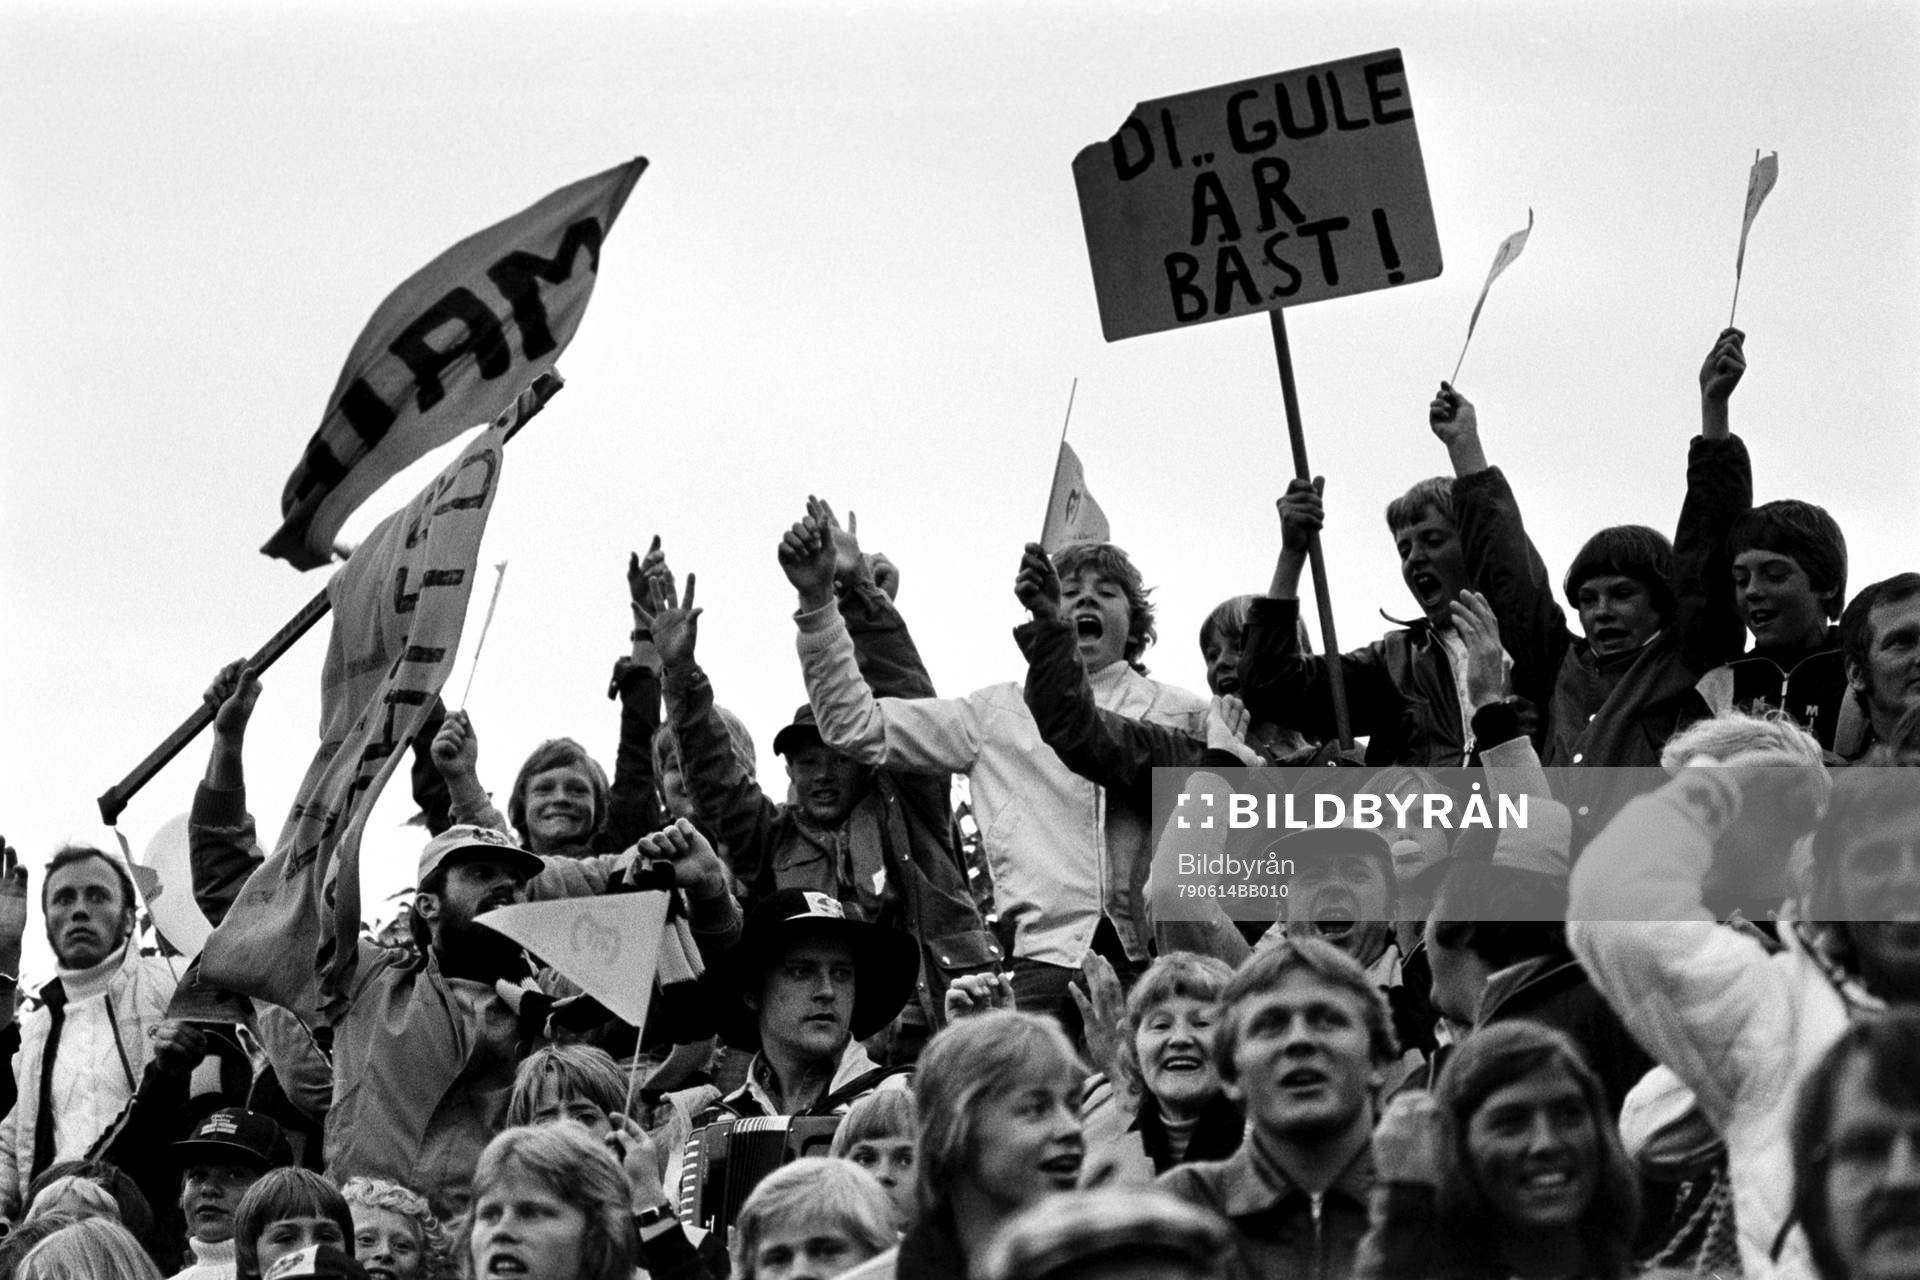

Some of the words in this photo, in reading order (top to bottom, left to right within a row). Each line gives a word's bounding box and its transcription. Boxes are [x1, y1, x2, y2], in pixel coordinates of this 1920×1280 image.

[1112, 108, 1183, 182] DI
[1226, 57, 1413, 155] GULE
[1190, 152, 1307, 247] ÄR
